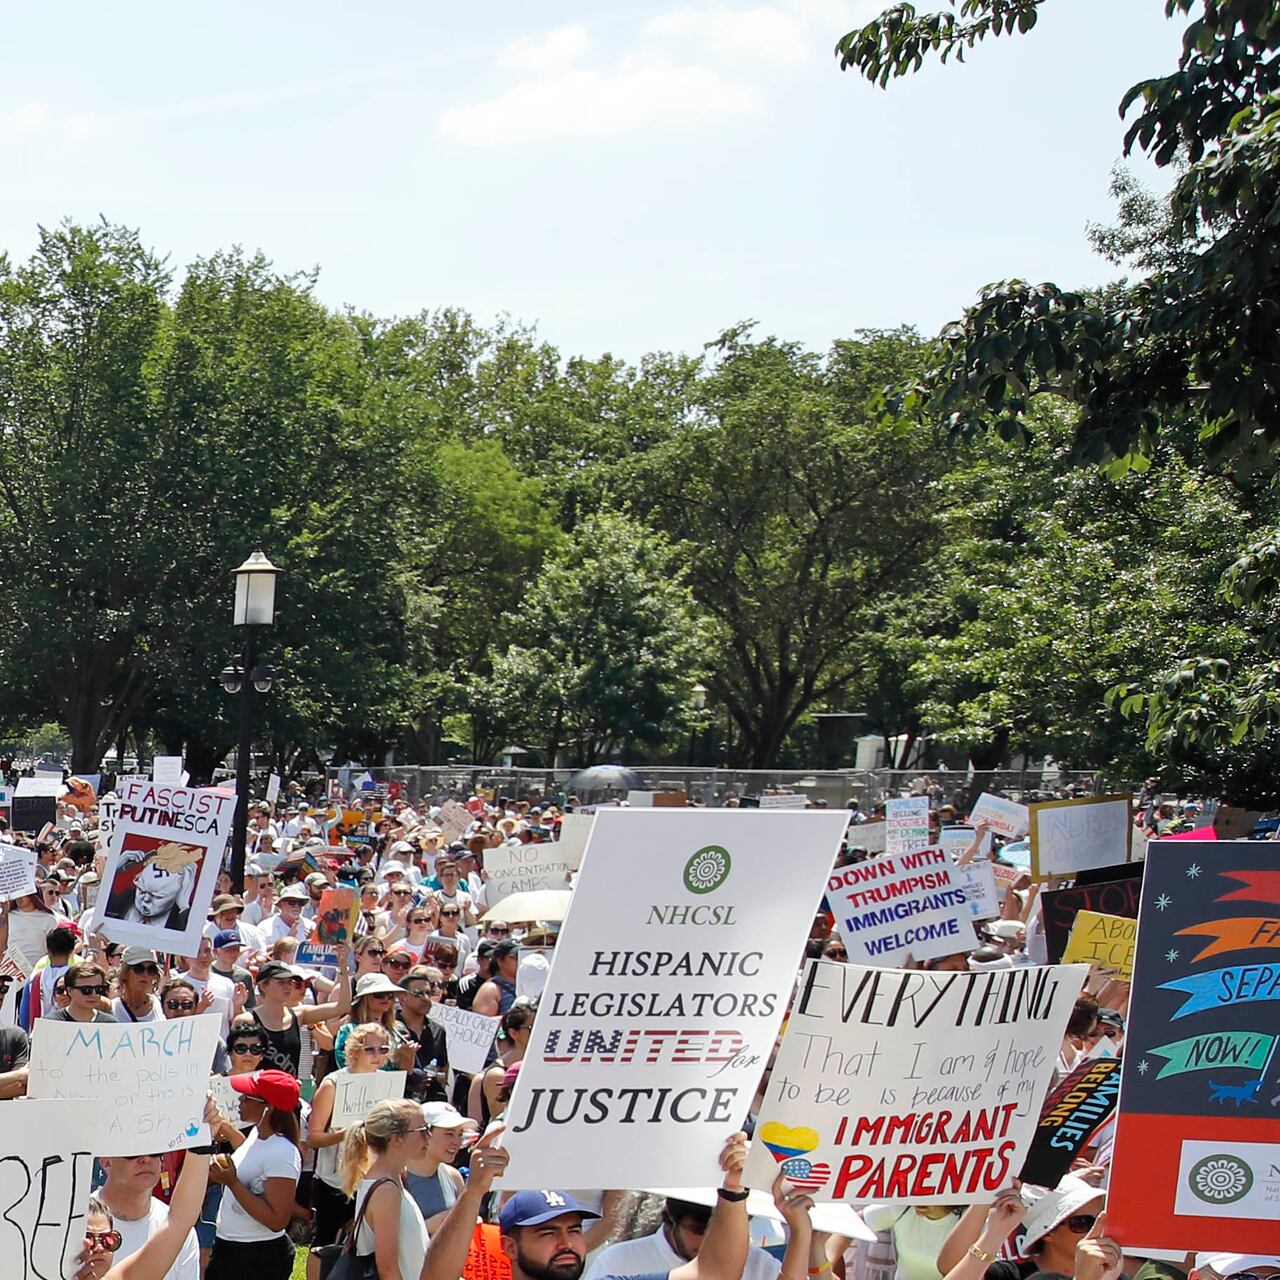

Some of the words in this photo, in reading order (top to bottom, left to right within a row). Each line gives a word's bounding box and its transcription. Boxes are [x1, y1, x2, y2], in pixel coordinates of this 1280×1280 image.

[128, 783, 227, 815] FASCIST
[119, 807, 218, 836] PUTINESCA
[828, 860, 895, 891] DOWN
[900, 849, 945, 871] WITH
[846, 871, 951, 908] TRUMPISM
[645, 904, 737, 926] NHCSL
[845, 889, 966, 933] IMMIGRANTS
[864, 918, 959, 956] WELCOME
[589, 951, 763, 977] HISPANIC
[549, 993, 777, 1018] LEGISLATORS
[798, 961, 1058, 1028] EVERYTHING
[66, 1020, 196, 1059] MARCH
[543, 1029, 743, 1064] UNITED
[1184, 1036, 1255, 1070] NOW!
[512, 1087, 738, 1133] JUSTICE
[834, 1102, 1018, 1146] IMMIGRANT
[831, 1140, 1016, 1200] PARENTS
